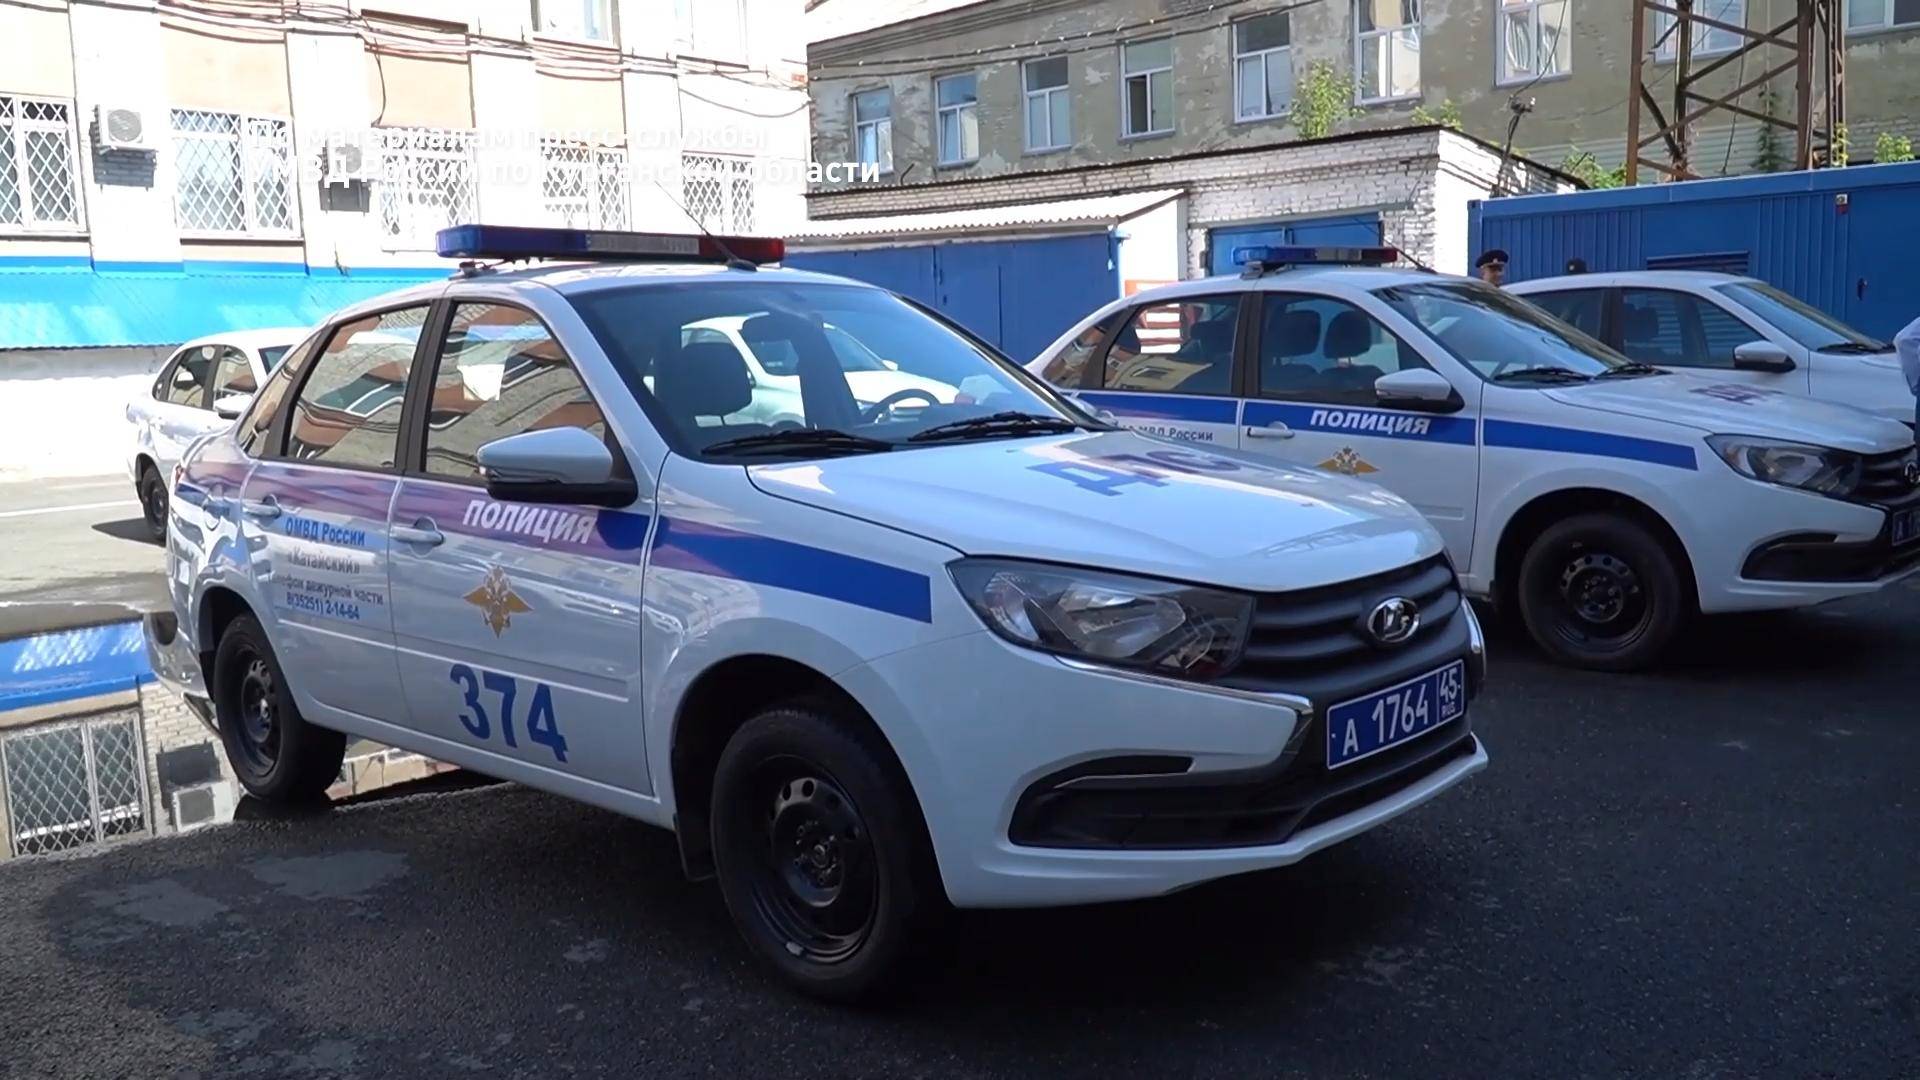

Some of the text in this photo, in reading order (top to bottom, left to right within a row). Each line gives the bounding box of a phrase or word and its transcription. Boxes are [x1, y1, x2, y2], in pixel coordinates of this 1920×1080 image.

[1311, 410, 1432, 434] ПОЛИЦИЯ
[286, 517, 366, 546] ОМВД России
[463, 500, 597, 544] ПОЛИЦИЯ
[450, 663, 569, 764] 374
[1371, 683, 1429, 744] 1764
[1440, 667, 1458, 703] 45
